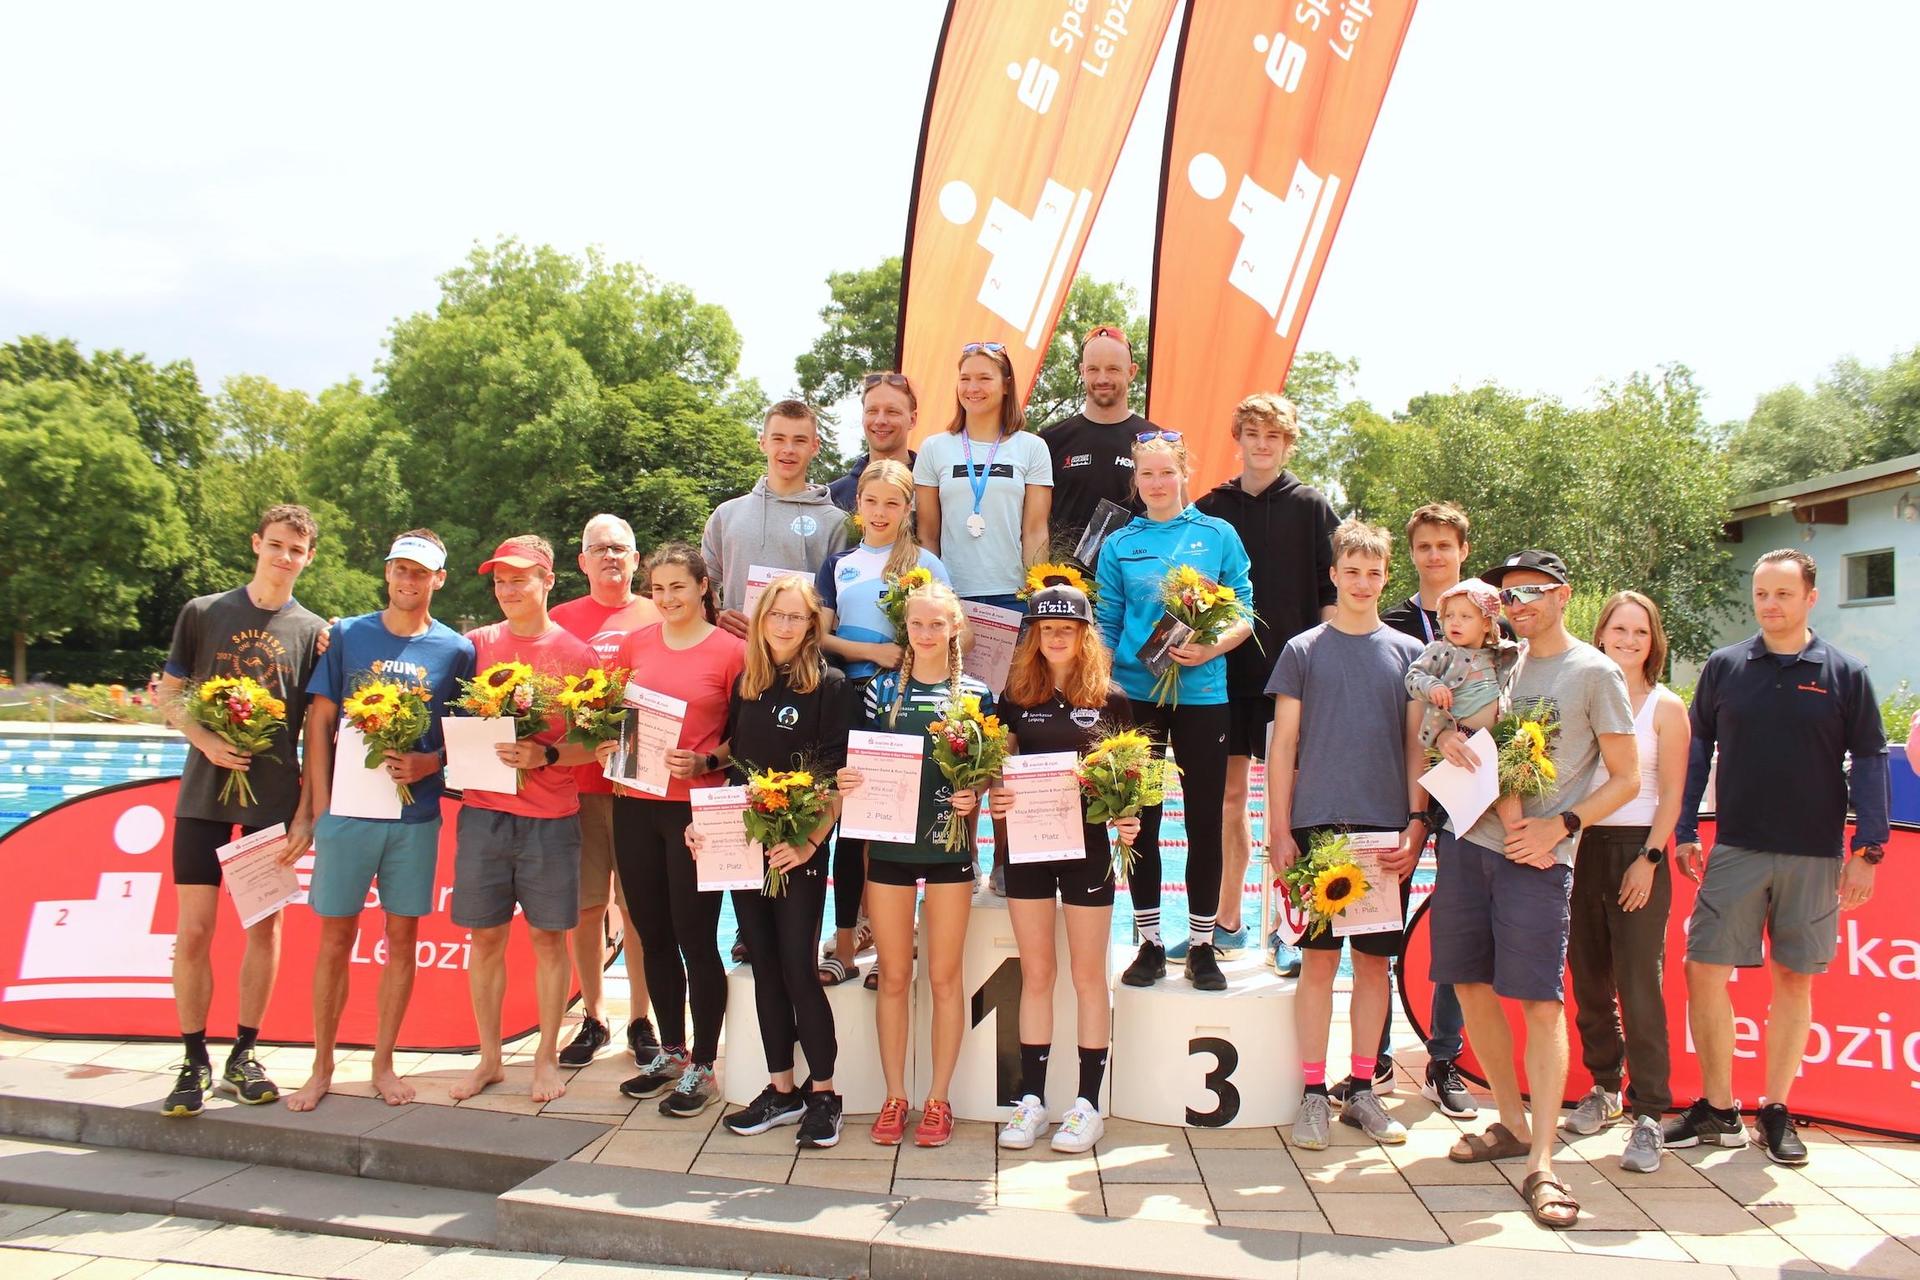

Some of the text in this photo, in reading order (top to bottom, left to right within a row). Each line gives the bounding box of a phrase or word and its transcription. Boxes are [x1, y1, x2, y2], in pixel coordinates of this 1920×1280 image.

[231, 629, 287, 656] SAILFISH
[382, 659, 418, 676] RUN
[121, 879, 133, 898] 1
[54, 908, 70, 927] 2
[971, 956, 1024, 1107] 1
[1184, 1036, 1241, 1128] 3
